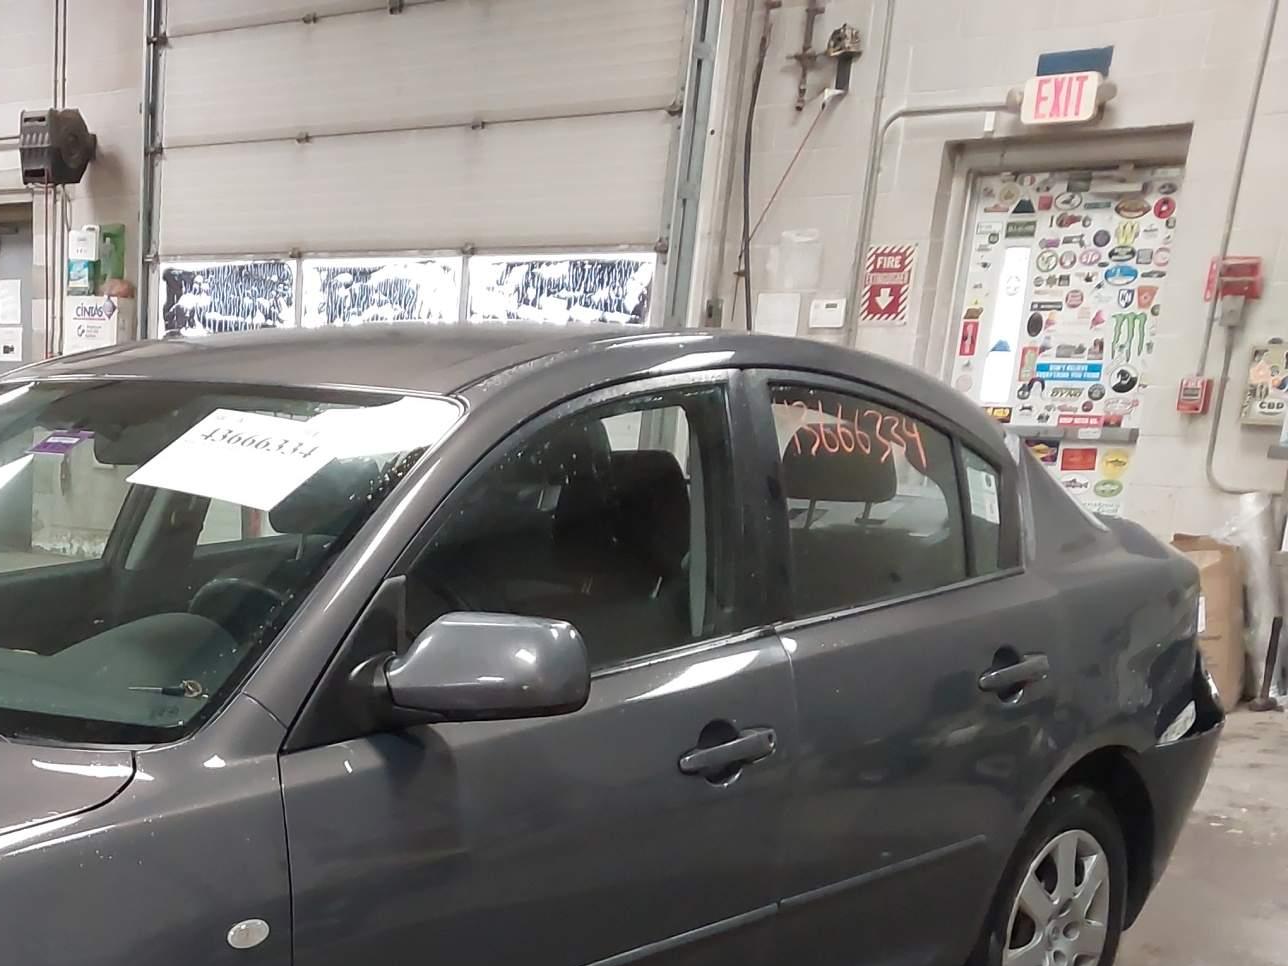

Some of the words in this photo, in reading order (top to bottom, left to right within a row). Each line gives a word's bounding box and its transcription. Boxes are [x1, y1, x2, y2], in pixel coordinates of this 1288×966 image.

[1034, 75, 1088, 119] EXIT
[876, 255, 902, 269] FIRE
[75, 302, 103, 317] CINTAS
[1258, 401, 1284, 410] CBD
[200, 428, 319, 458] 43666334
